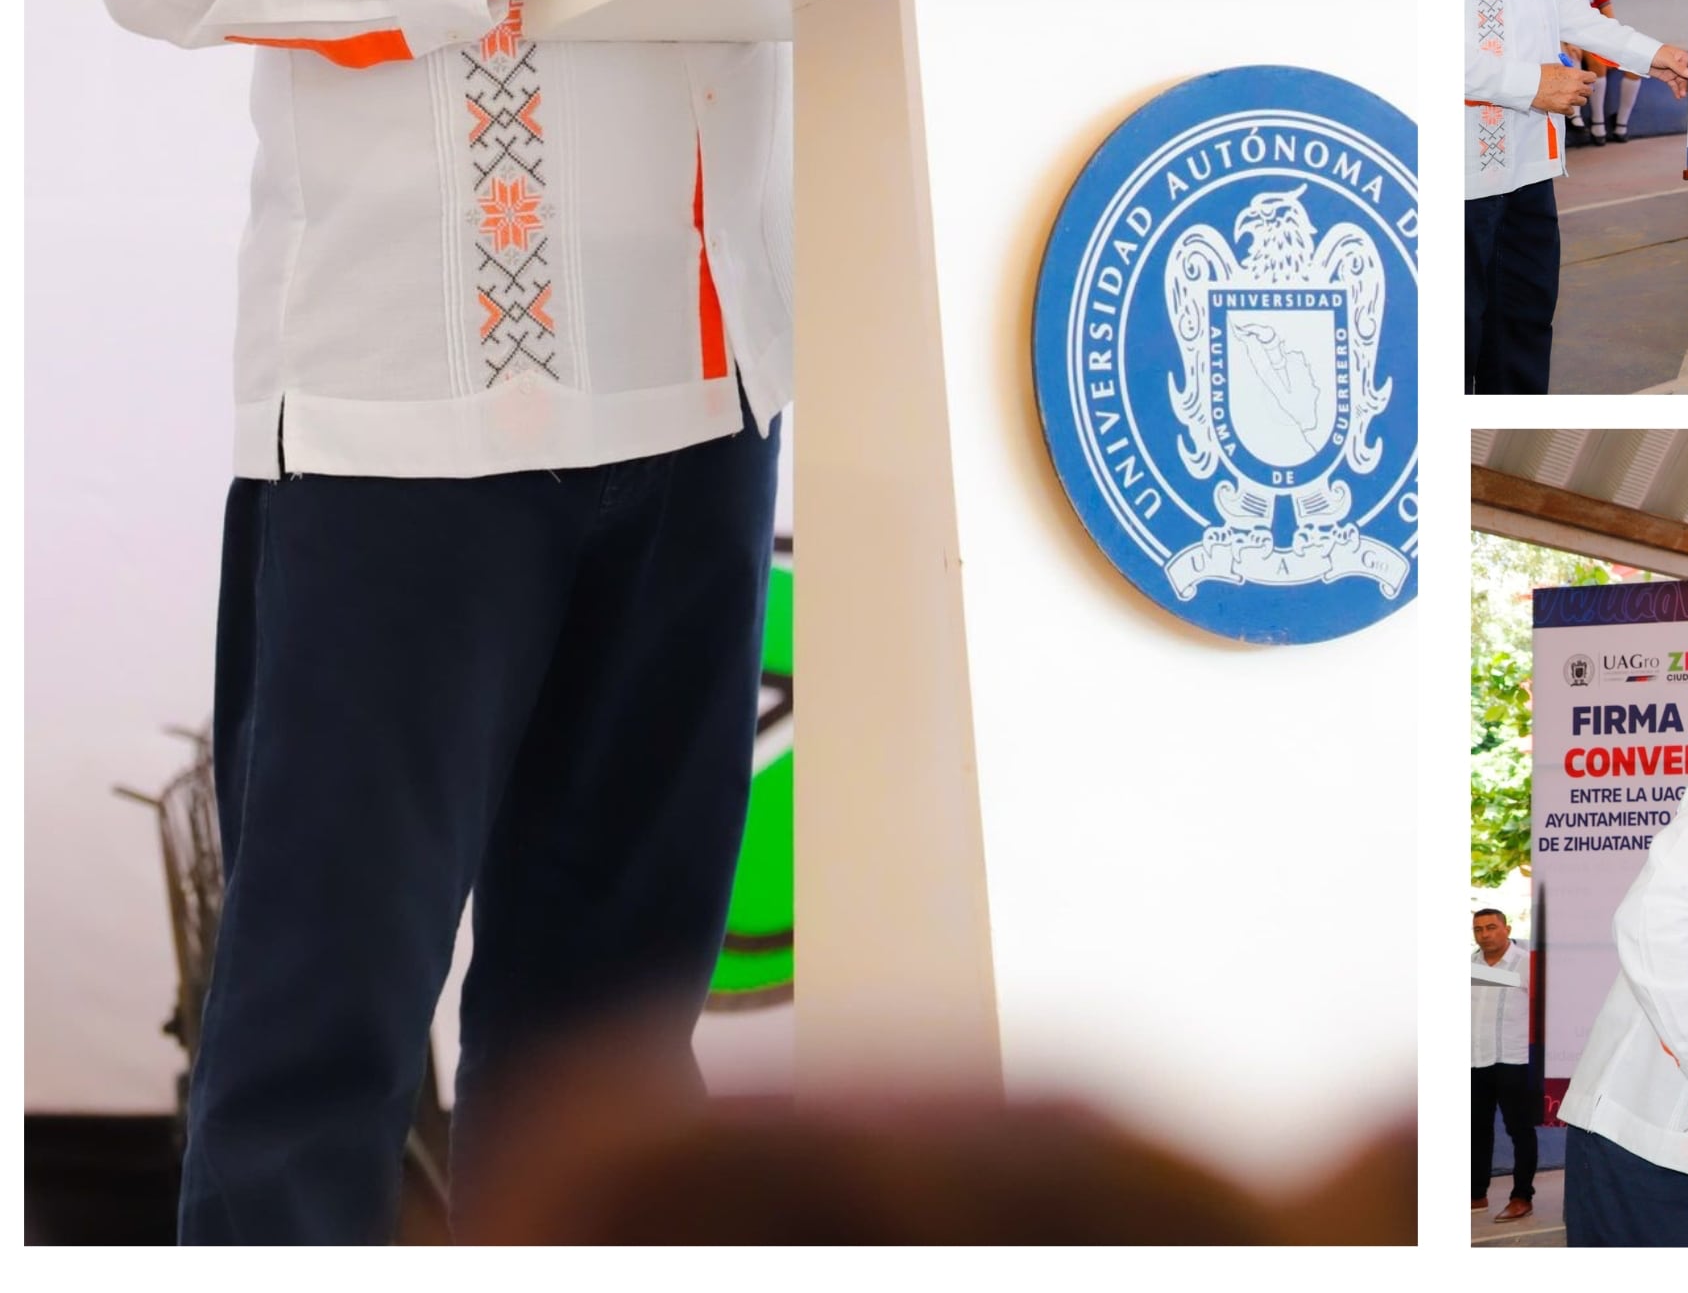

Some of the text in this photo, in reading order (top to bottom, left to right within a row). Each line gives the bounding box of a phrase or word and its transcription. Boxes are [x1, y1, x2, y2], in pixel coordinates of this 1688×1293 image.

[1212, 294, 1343, 307] UNIVERSIDAD
[1090, 125, 1385, 523] UNIVERSIDAD AUTÓNOMA
[1210, 326, 1237, 457] AUTÓNOMA
[1333, 328, 1348, 445] GUERRERO
[1272, 471, 1295, 484] DE
[1276, 558, 1289, 575] A
[1603, 654, 1660, 670] UAGro
[1572, 703, 1684, 736] FIRMA
[1570, 786, 1687, 804] ENTRE LA UAG
[1545, 811, 1671, 828] AYUNTAMIENTO
[1539, 835, 1653, 852] DE ZIHUATANE
